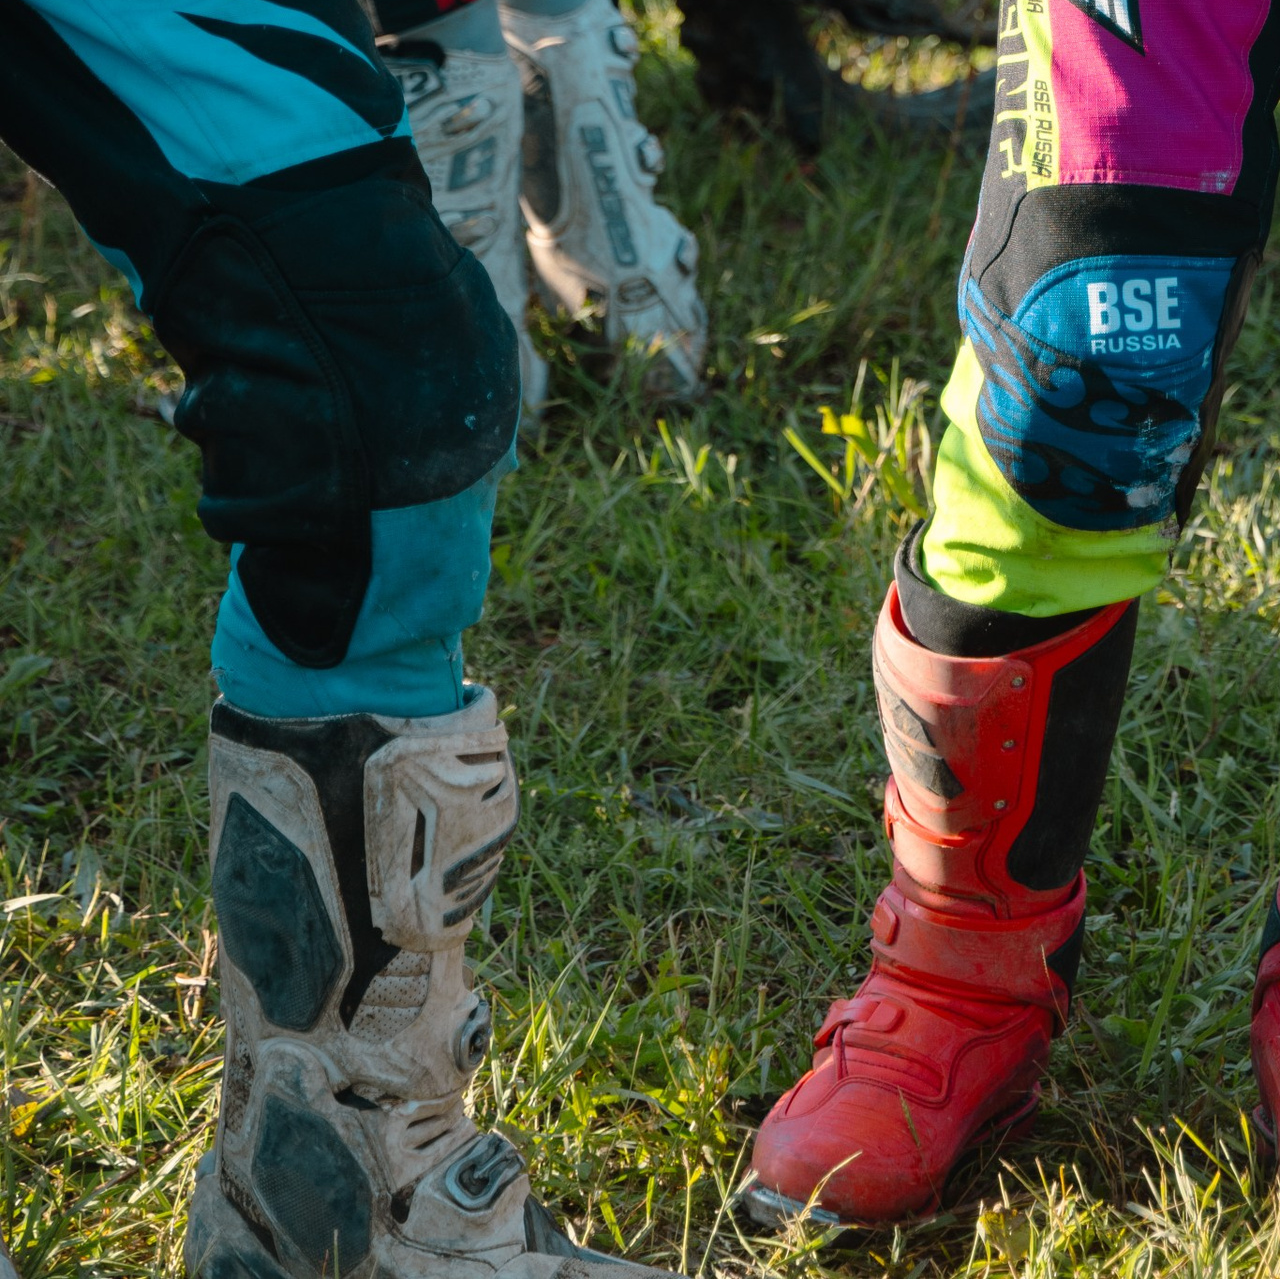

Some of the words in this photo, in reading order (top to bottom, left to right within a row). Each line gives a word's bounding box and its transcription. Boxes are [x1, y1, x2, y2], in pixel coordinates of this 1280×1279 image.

[1034, 79, 1052, 114] BSE
[1031, 118, 1053, 179] RUSSIA
[1086, 276, 1182, 336] BSE
[1090, 333, 1182, 355] RUSSIA
